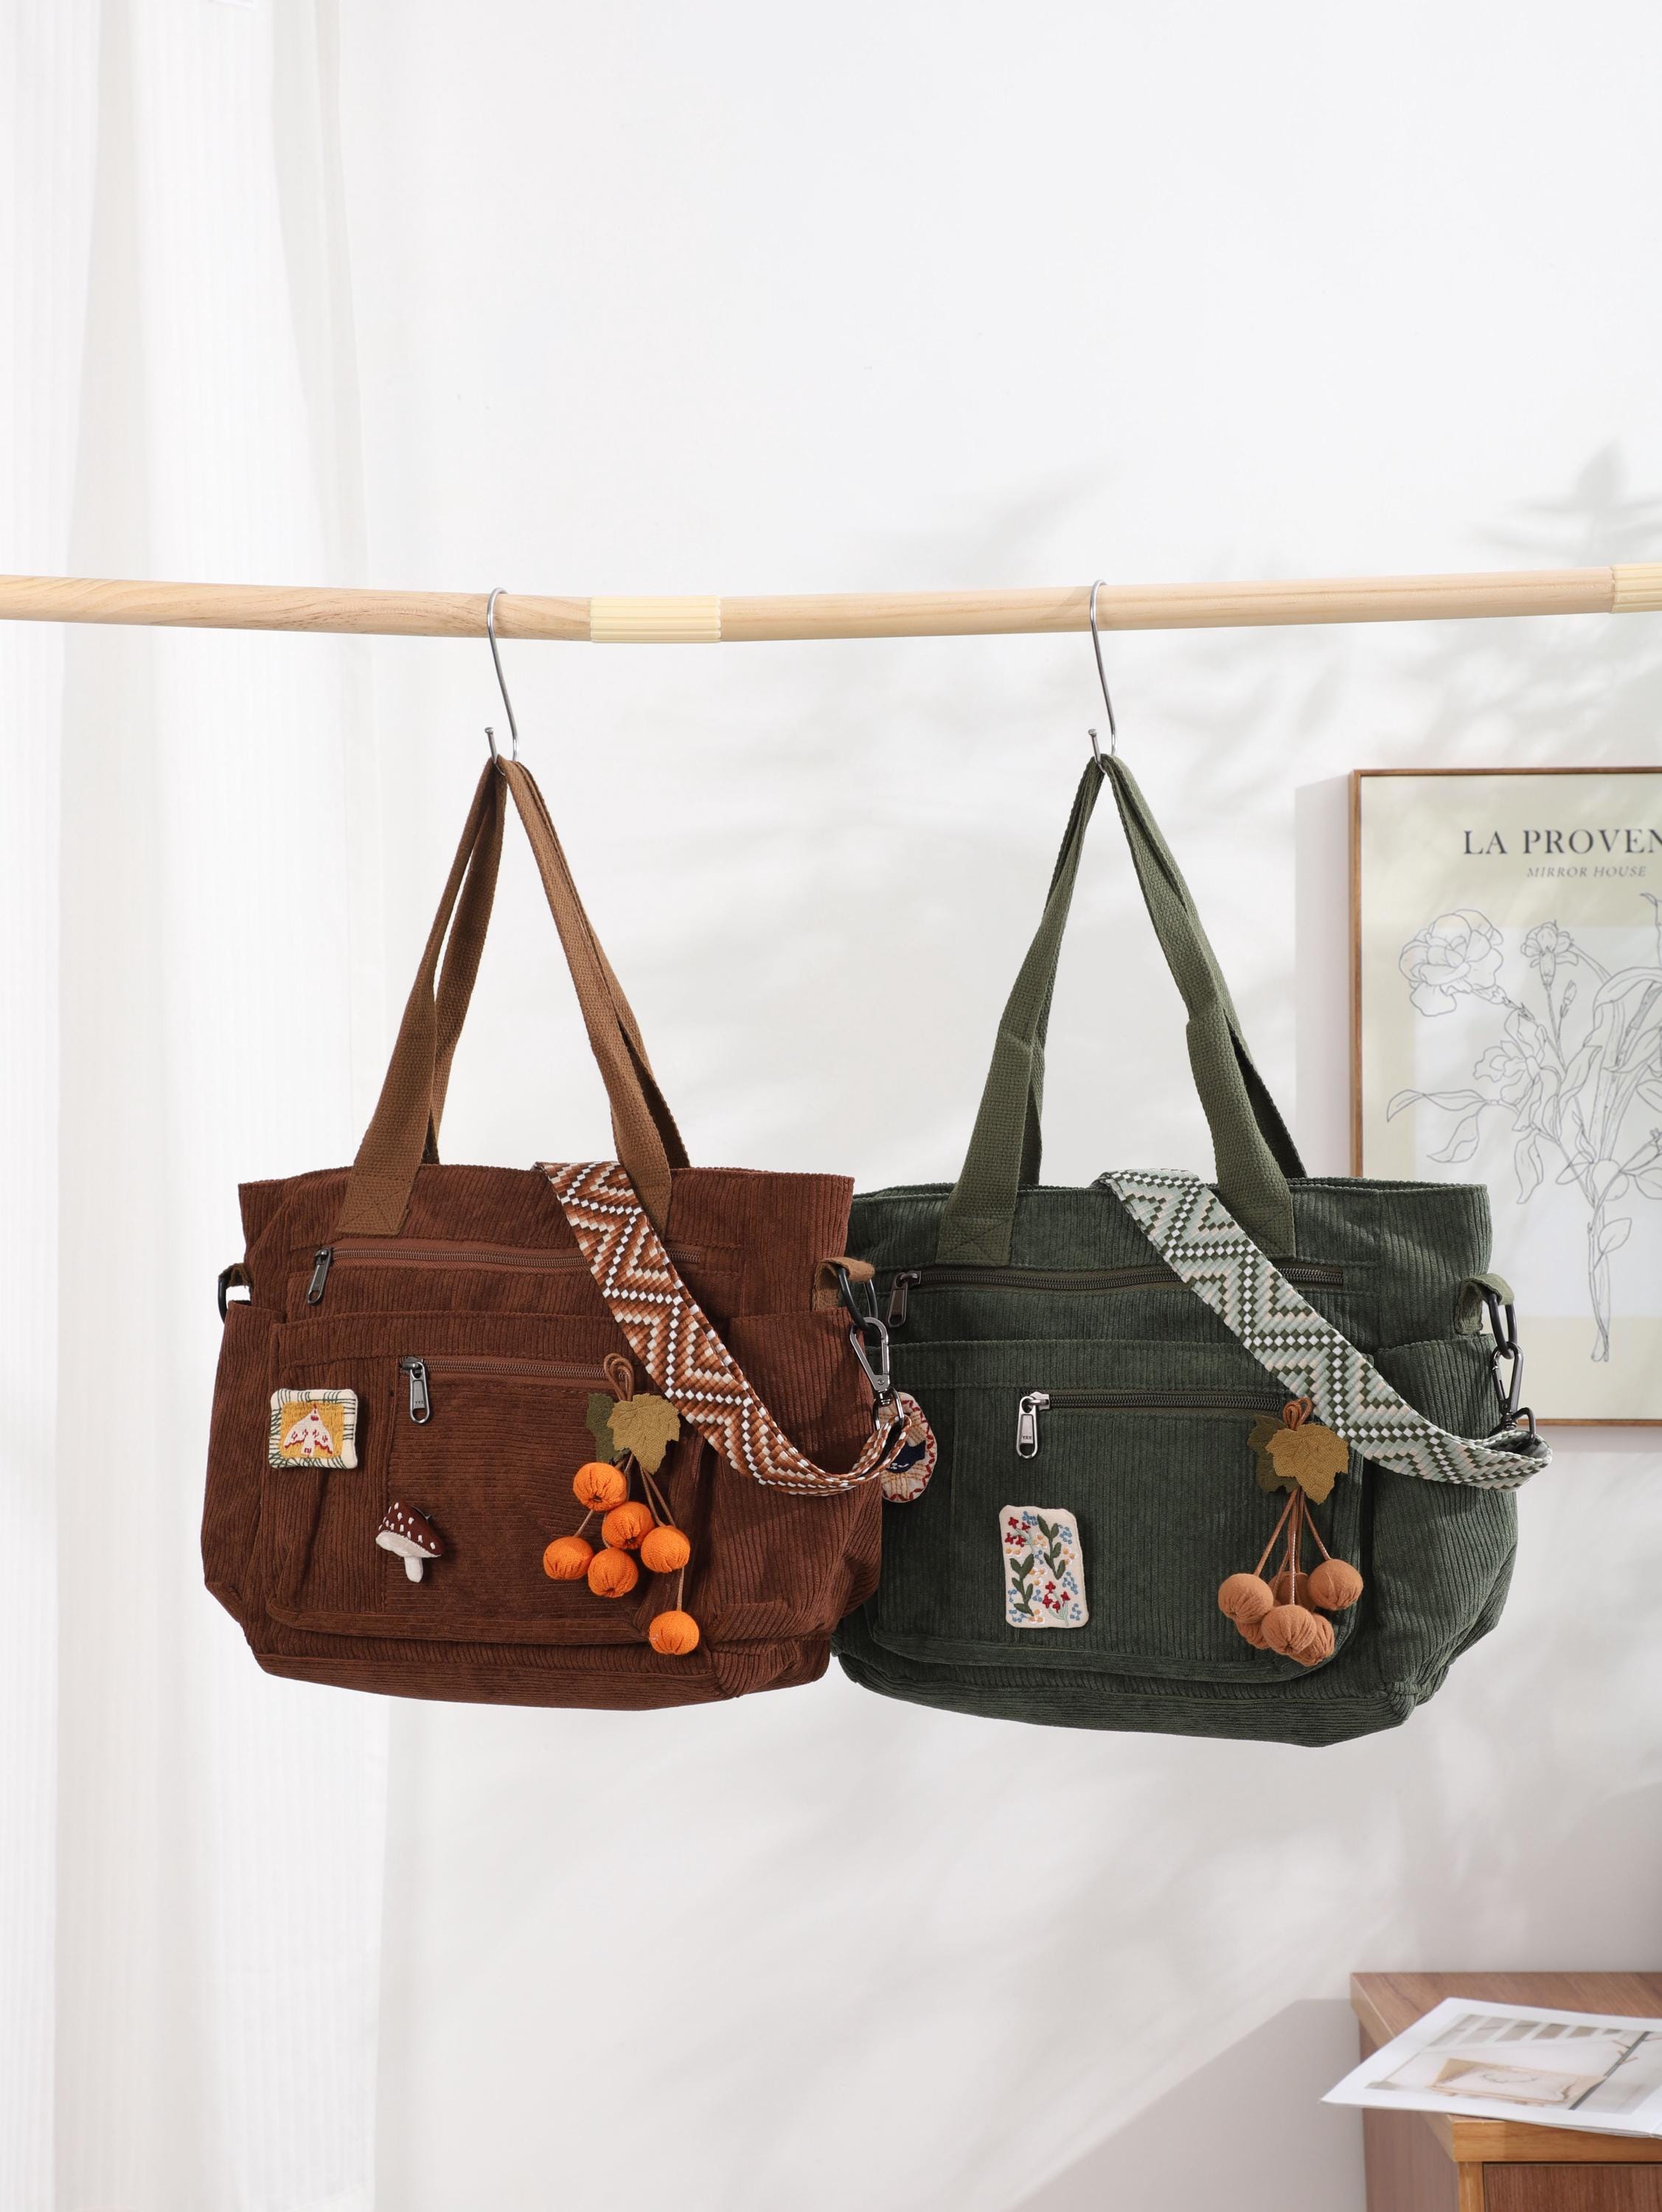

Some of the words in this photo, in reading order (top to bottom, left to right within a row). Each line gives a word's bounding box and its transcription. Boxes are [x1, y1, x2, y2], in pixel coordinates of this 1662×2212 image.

[1463, 830, 1508, 855] LA
[1526, 866, 1588, 878] MIRROR
[1593, 865, 1647, 878] HOUSE
